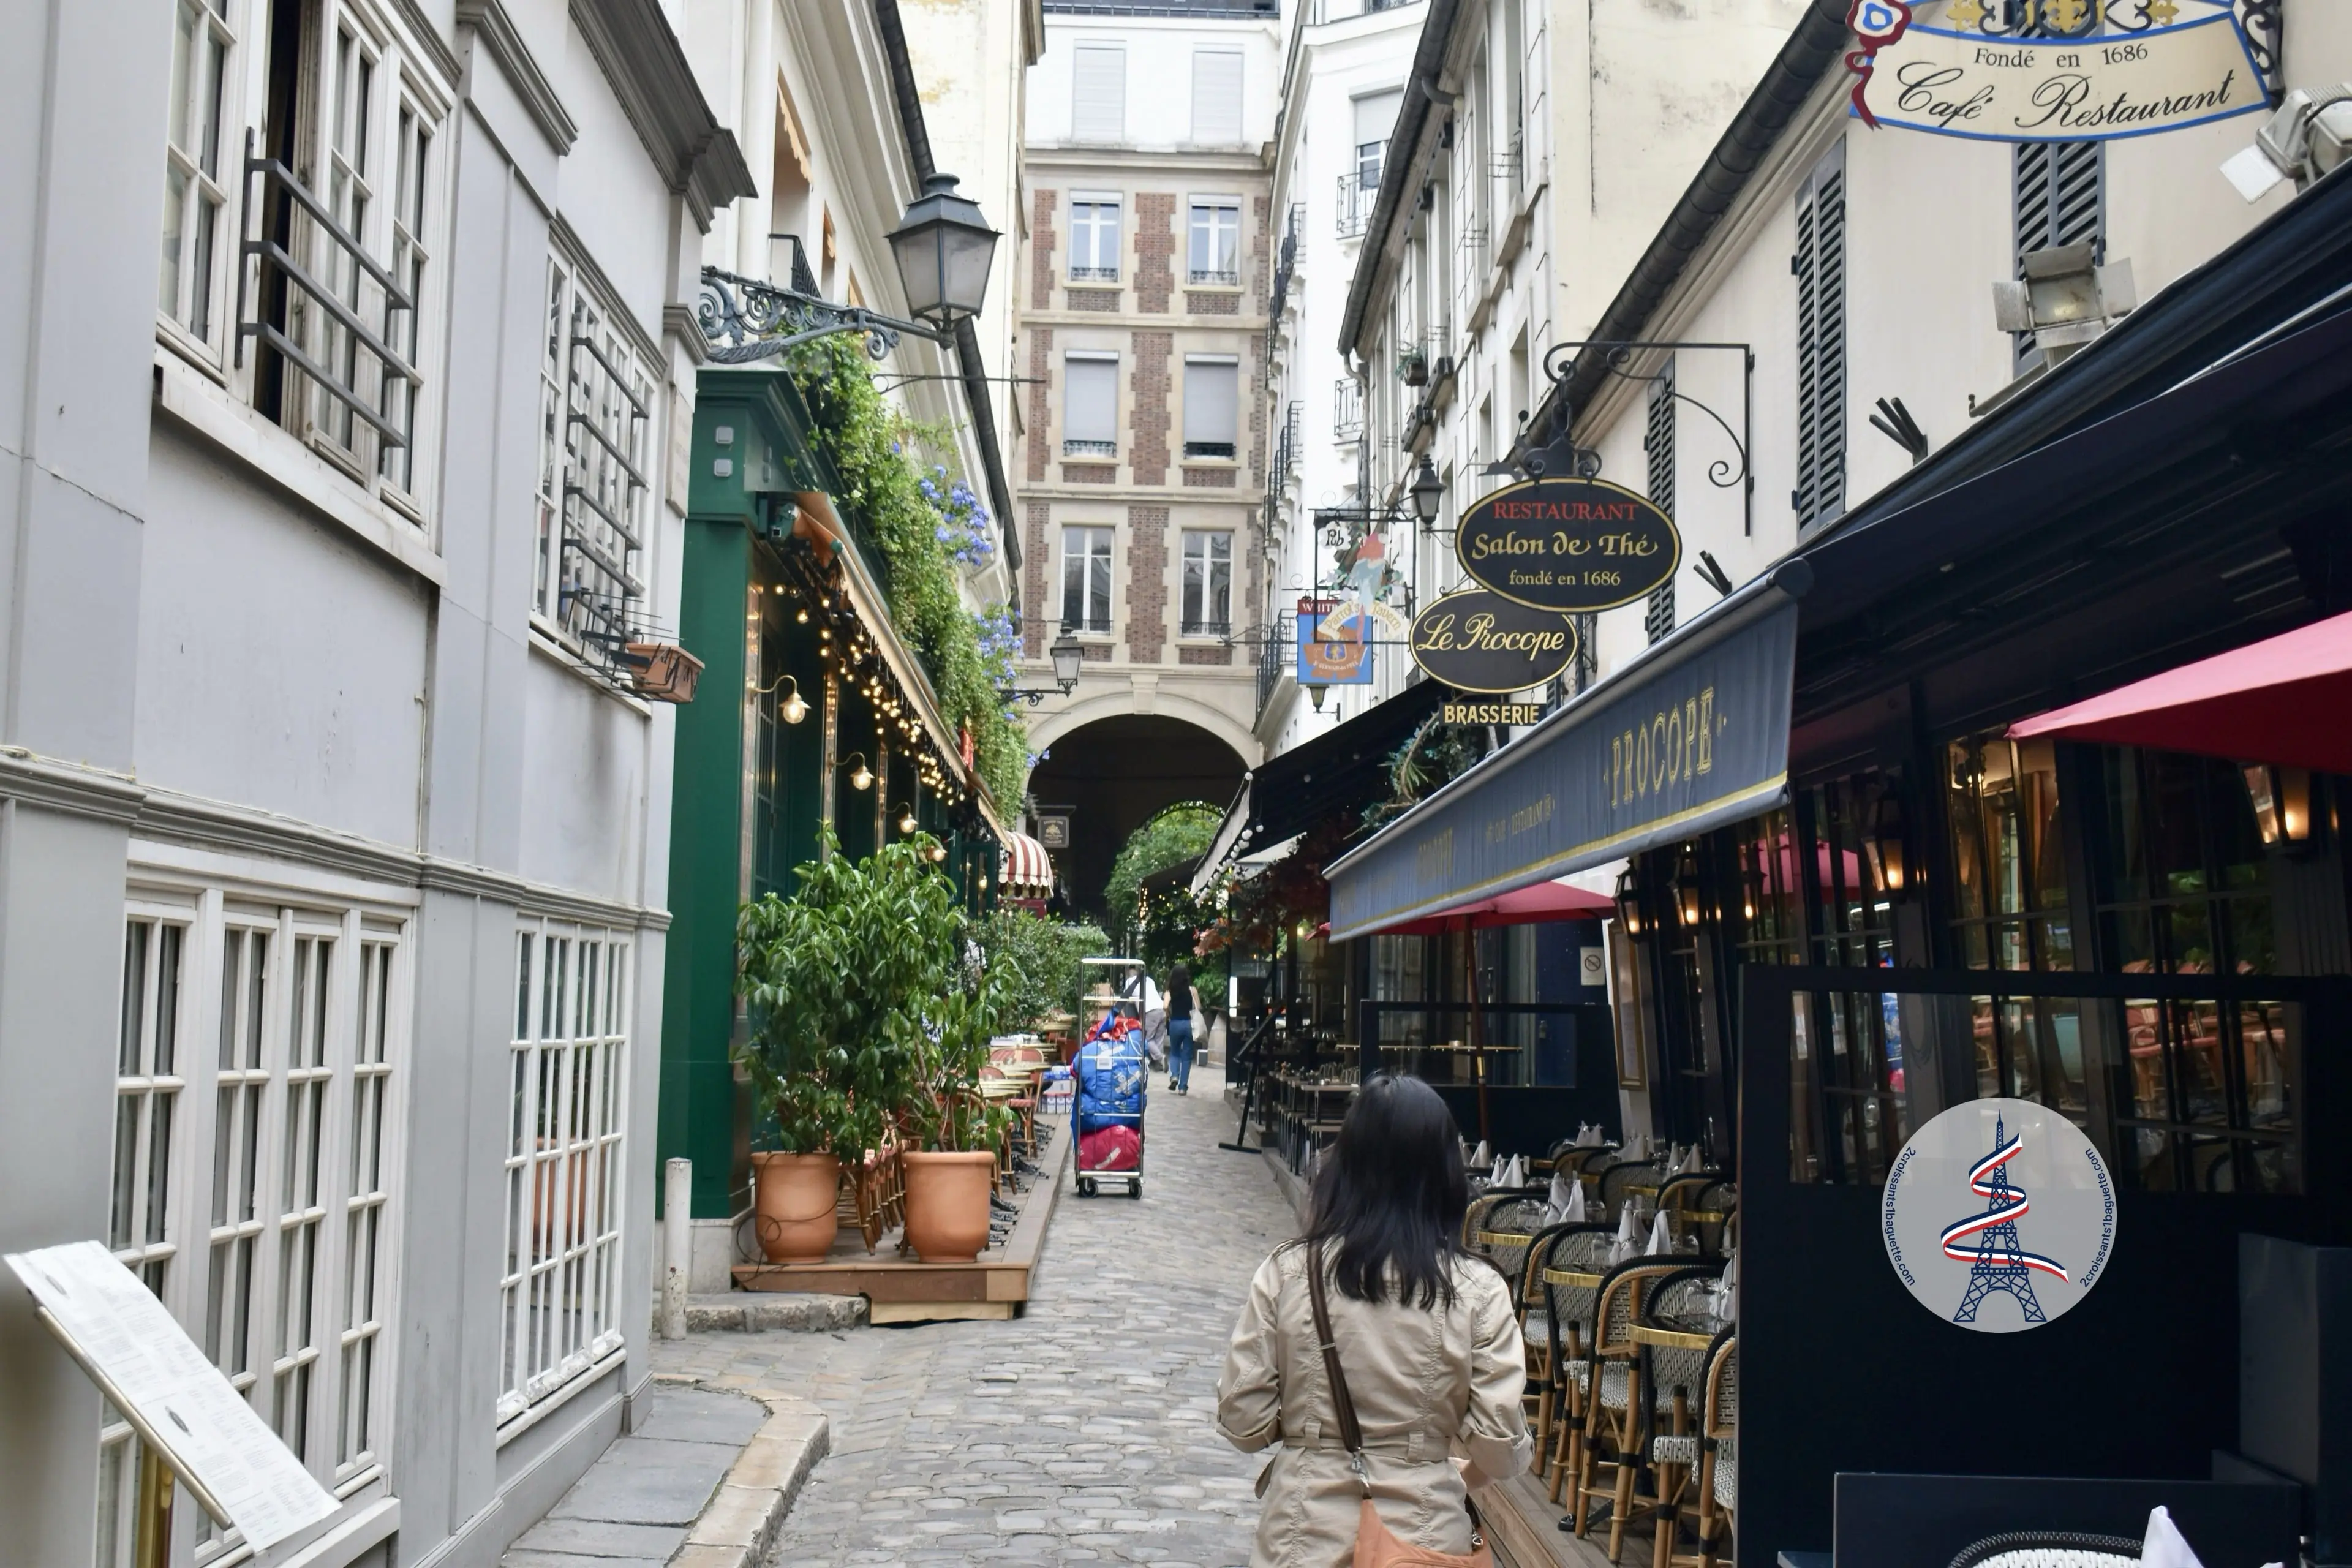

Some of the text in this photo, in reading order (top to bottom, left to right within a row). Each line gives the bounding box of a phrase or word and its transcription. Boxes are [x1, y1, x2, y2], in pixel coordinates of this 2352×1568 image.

[1974, 43, 2148, 67] Fondé en 1686
[1896, 62, 2234, 128] Café Restaurant
[1493, 502, 1639, 520] RESTAURANT
[1471, 531, 1659, 560] Salon de Thé
[1509, 569, 1621, 586] fondé en 1686
[1373, 602, 1401, 630] Tavern
[1416, 613, 1564, 662] Le Procope
[1444, 705, 1539, 725] BRASSERIE
[1611, 686, 1713, 809] PROCOPE
